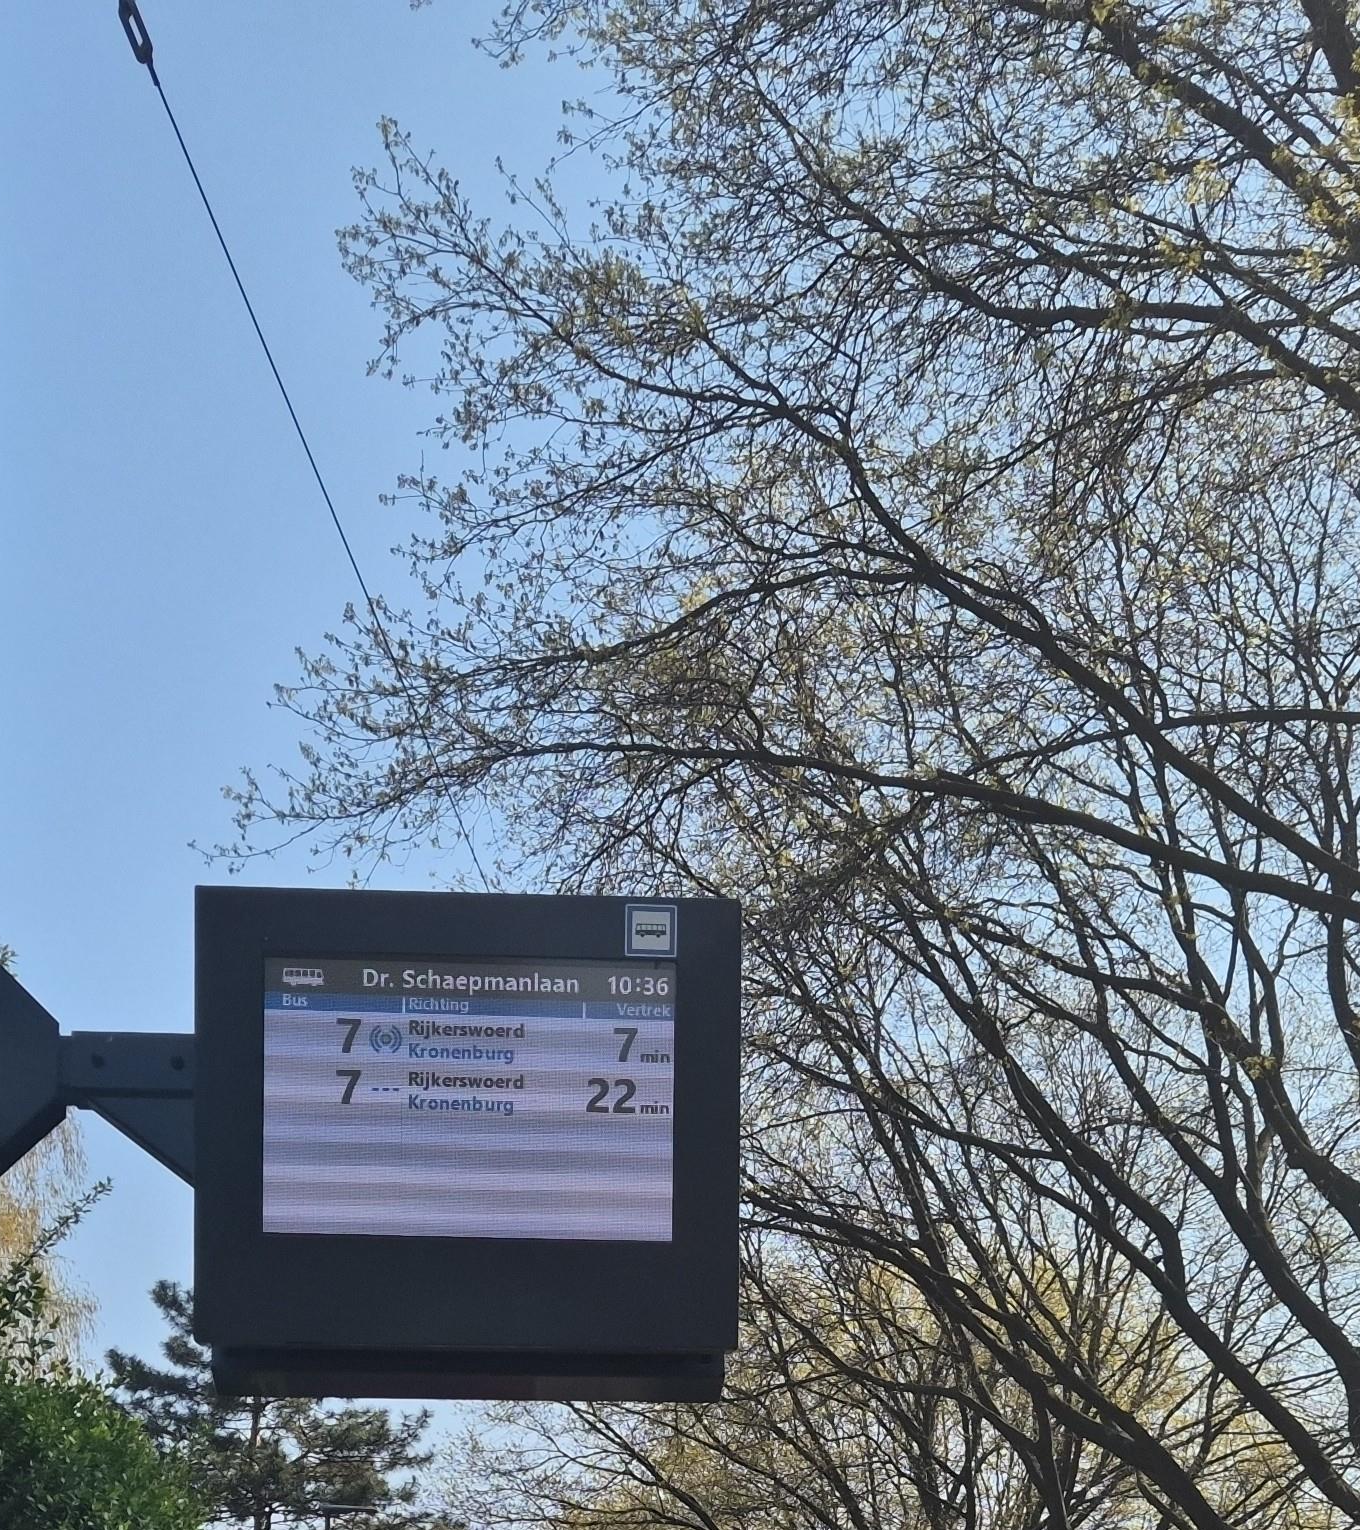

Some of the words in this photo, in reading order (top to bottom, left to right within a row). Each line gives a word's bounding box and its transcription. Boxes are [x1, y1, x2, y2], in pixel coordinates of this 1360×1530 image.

[362, 968, 394, 988] Dr.
[402, 969, 580, 996] Schaepmanlaan
[607, 975, 669, 996] 10:36
[282, 993, 308, 1007] Bus
[408, 997, 469, 1014] Richting
[616, 1002, 671, 1017] Vertrek
[336, 1017, 361, 1053] 7
[408, 1020, 525, 1040] Rijkerswoerd
[408, 1043, 514, 1064] Kronenburg
[613, 1027, 638, 1062] 7
[640, 1050, 671, 1063] min
[336, 1069, 361, 1104] 7
[408, 1071, 524, 1091] Rijkerswoerd
[408, 1094, 514, 1116] Kronenburg
[585, 1077, 637, 1113] 22
[640, 1101, 670, 1114] min
